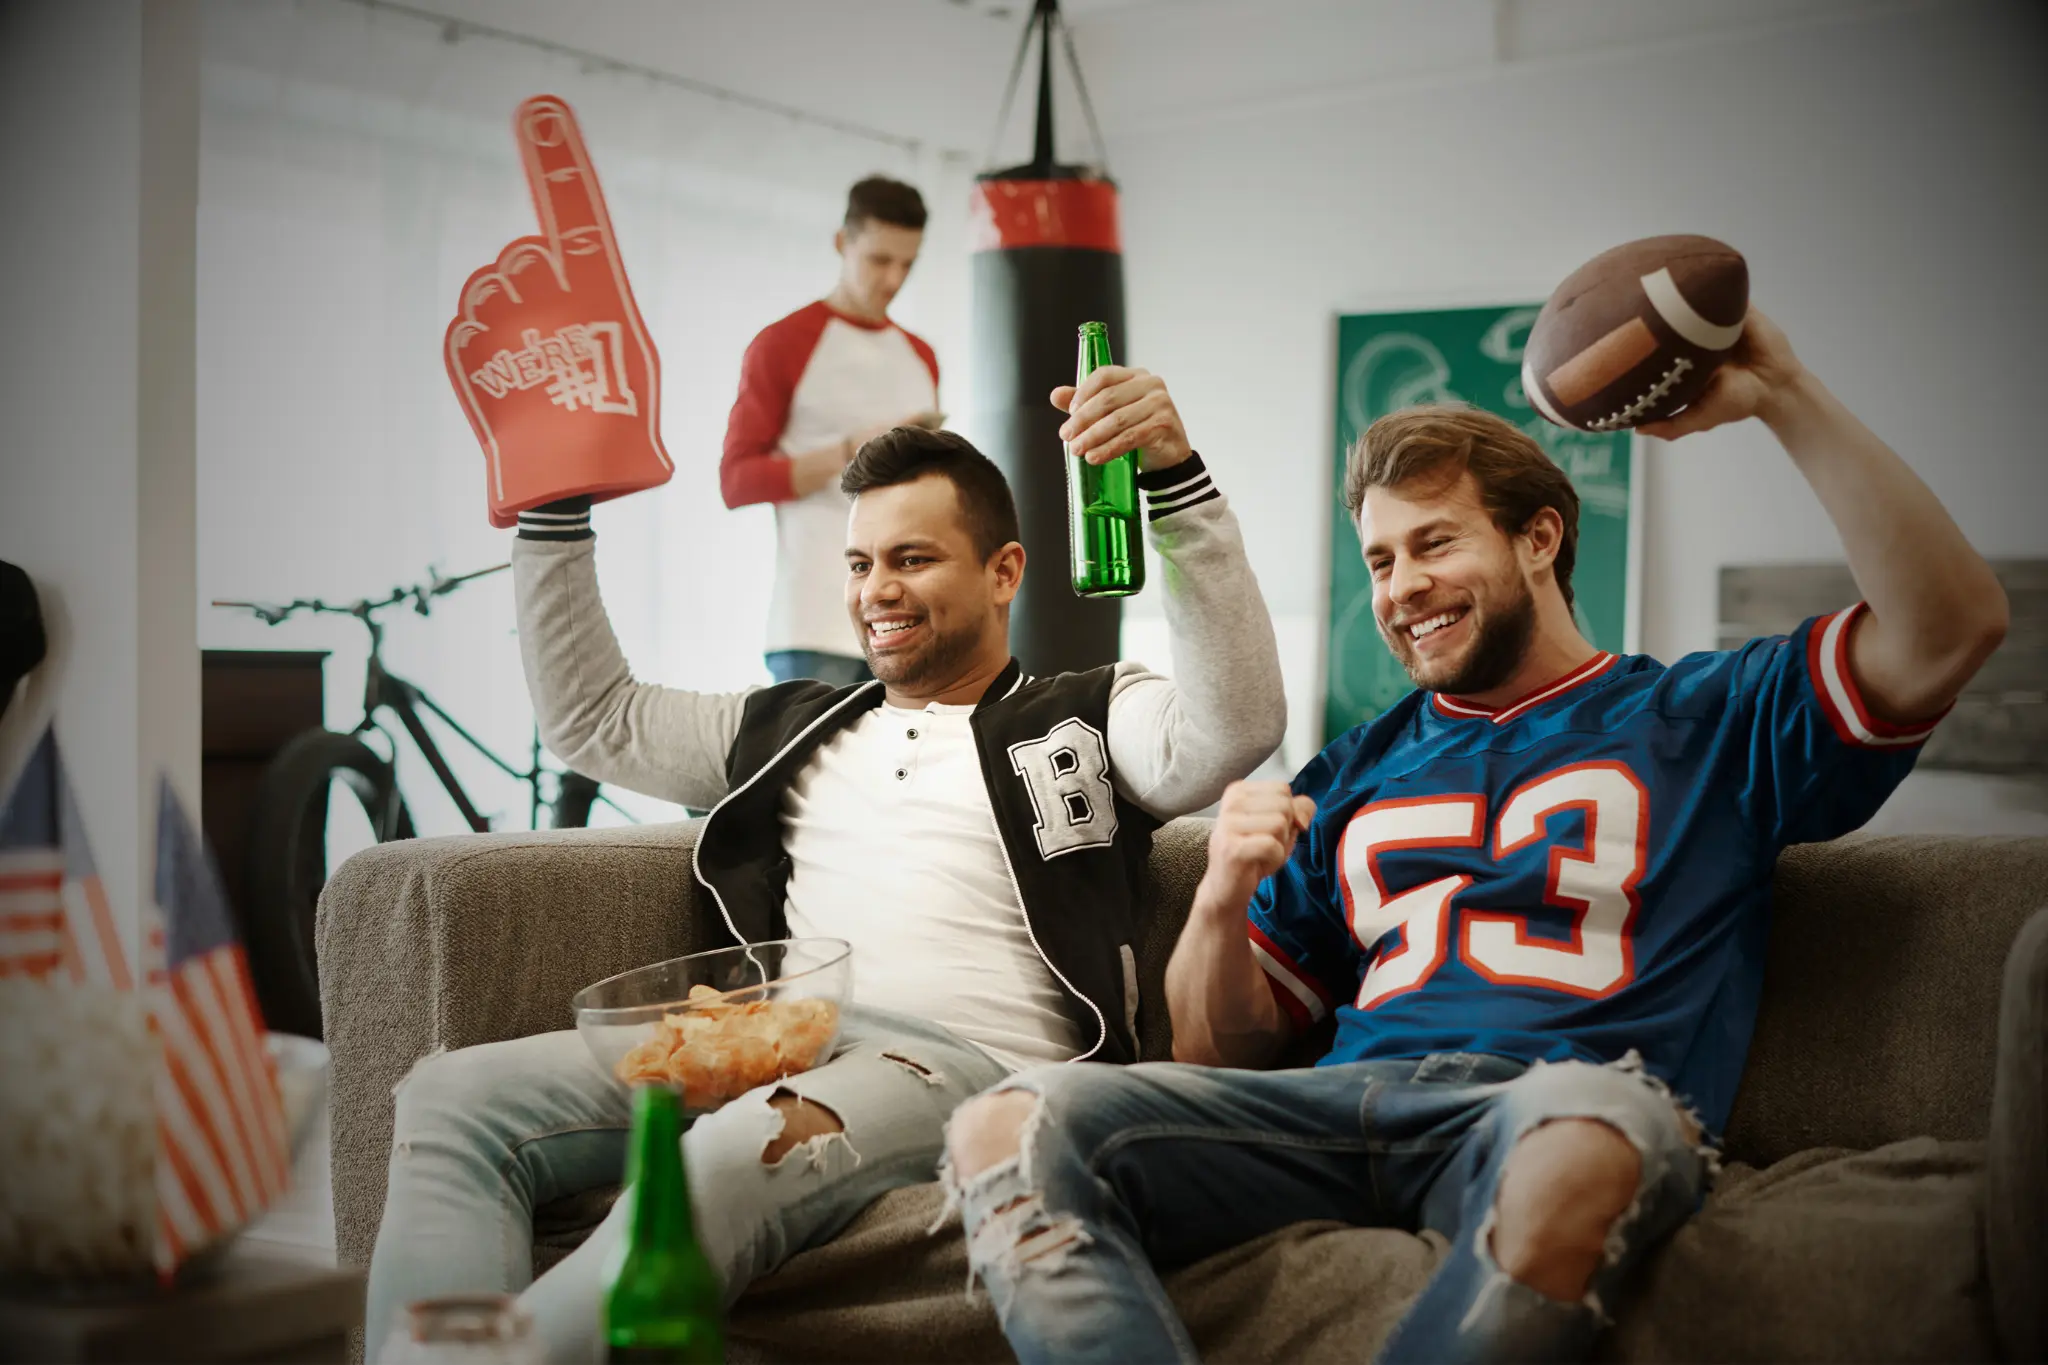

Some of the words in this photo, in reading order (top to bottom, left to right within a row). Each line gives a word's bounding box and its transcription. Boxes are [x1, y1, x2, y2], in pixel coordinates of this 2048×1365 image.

[545, 321, 638, 417] #1
[1007, 716, 1119, 861] B
[1336, 759, 1650, 1011] 53
